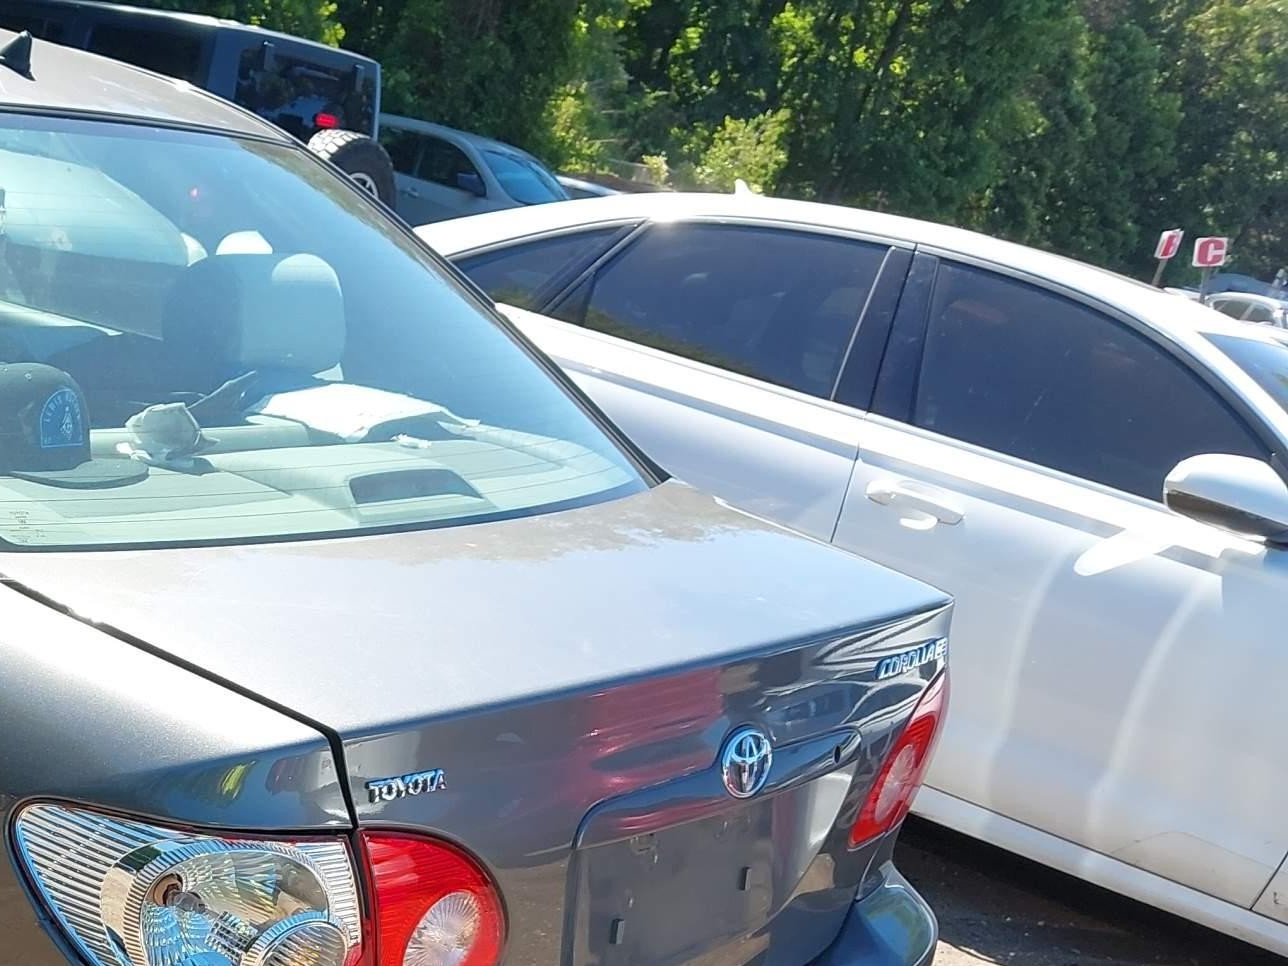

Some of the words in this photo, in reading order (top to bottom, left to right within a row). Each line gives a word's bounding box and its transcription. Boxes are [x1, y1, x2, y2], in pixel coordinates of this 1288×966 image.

[1197, 239, 1226, 265] C
[877, 643, 935, 680] COROLLA
[367, 769, 446, 802] TOYOTA
